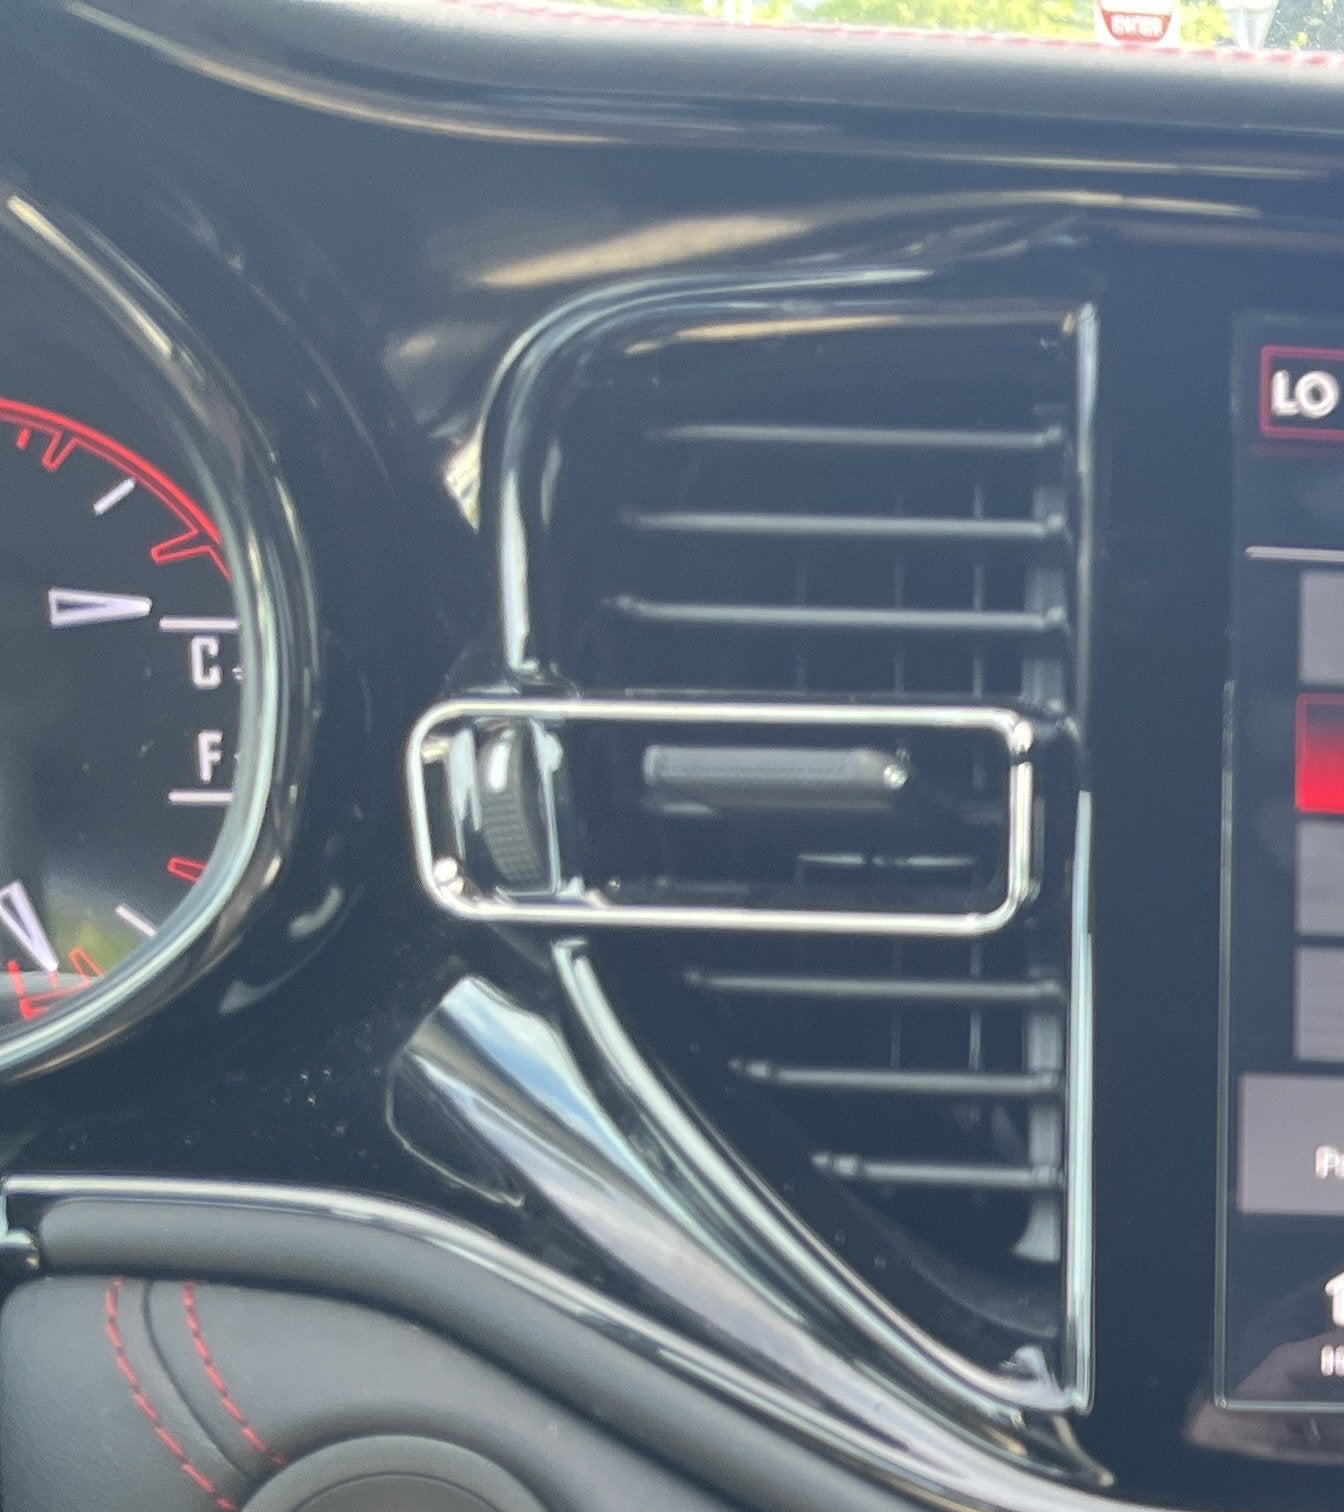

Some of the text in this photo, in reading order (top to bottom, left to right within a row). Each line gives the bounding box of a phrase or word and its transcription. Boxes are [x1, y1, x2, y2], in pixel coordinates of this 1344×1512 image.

[1272, 370, 1340, 418] LO
[190, 636, 223, 689] C
[197, 729, 223, 782] F
